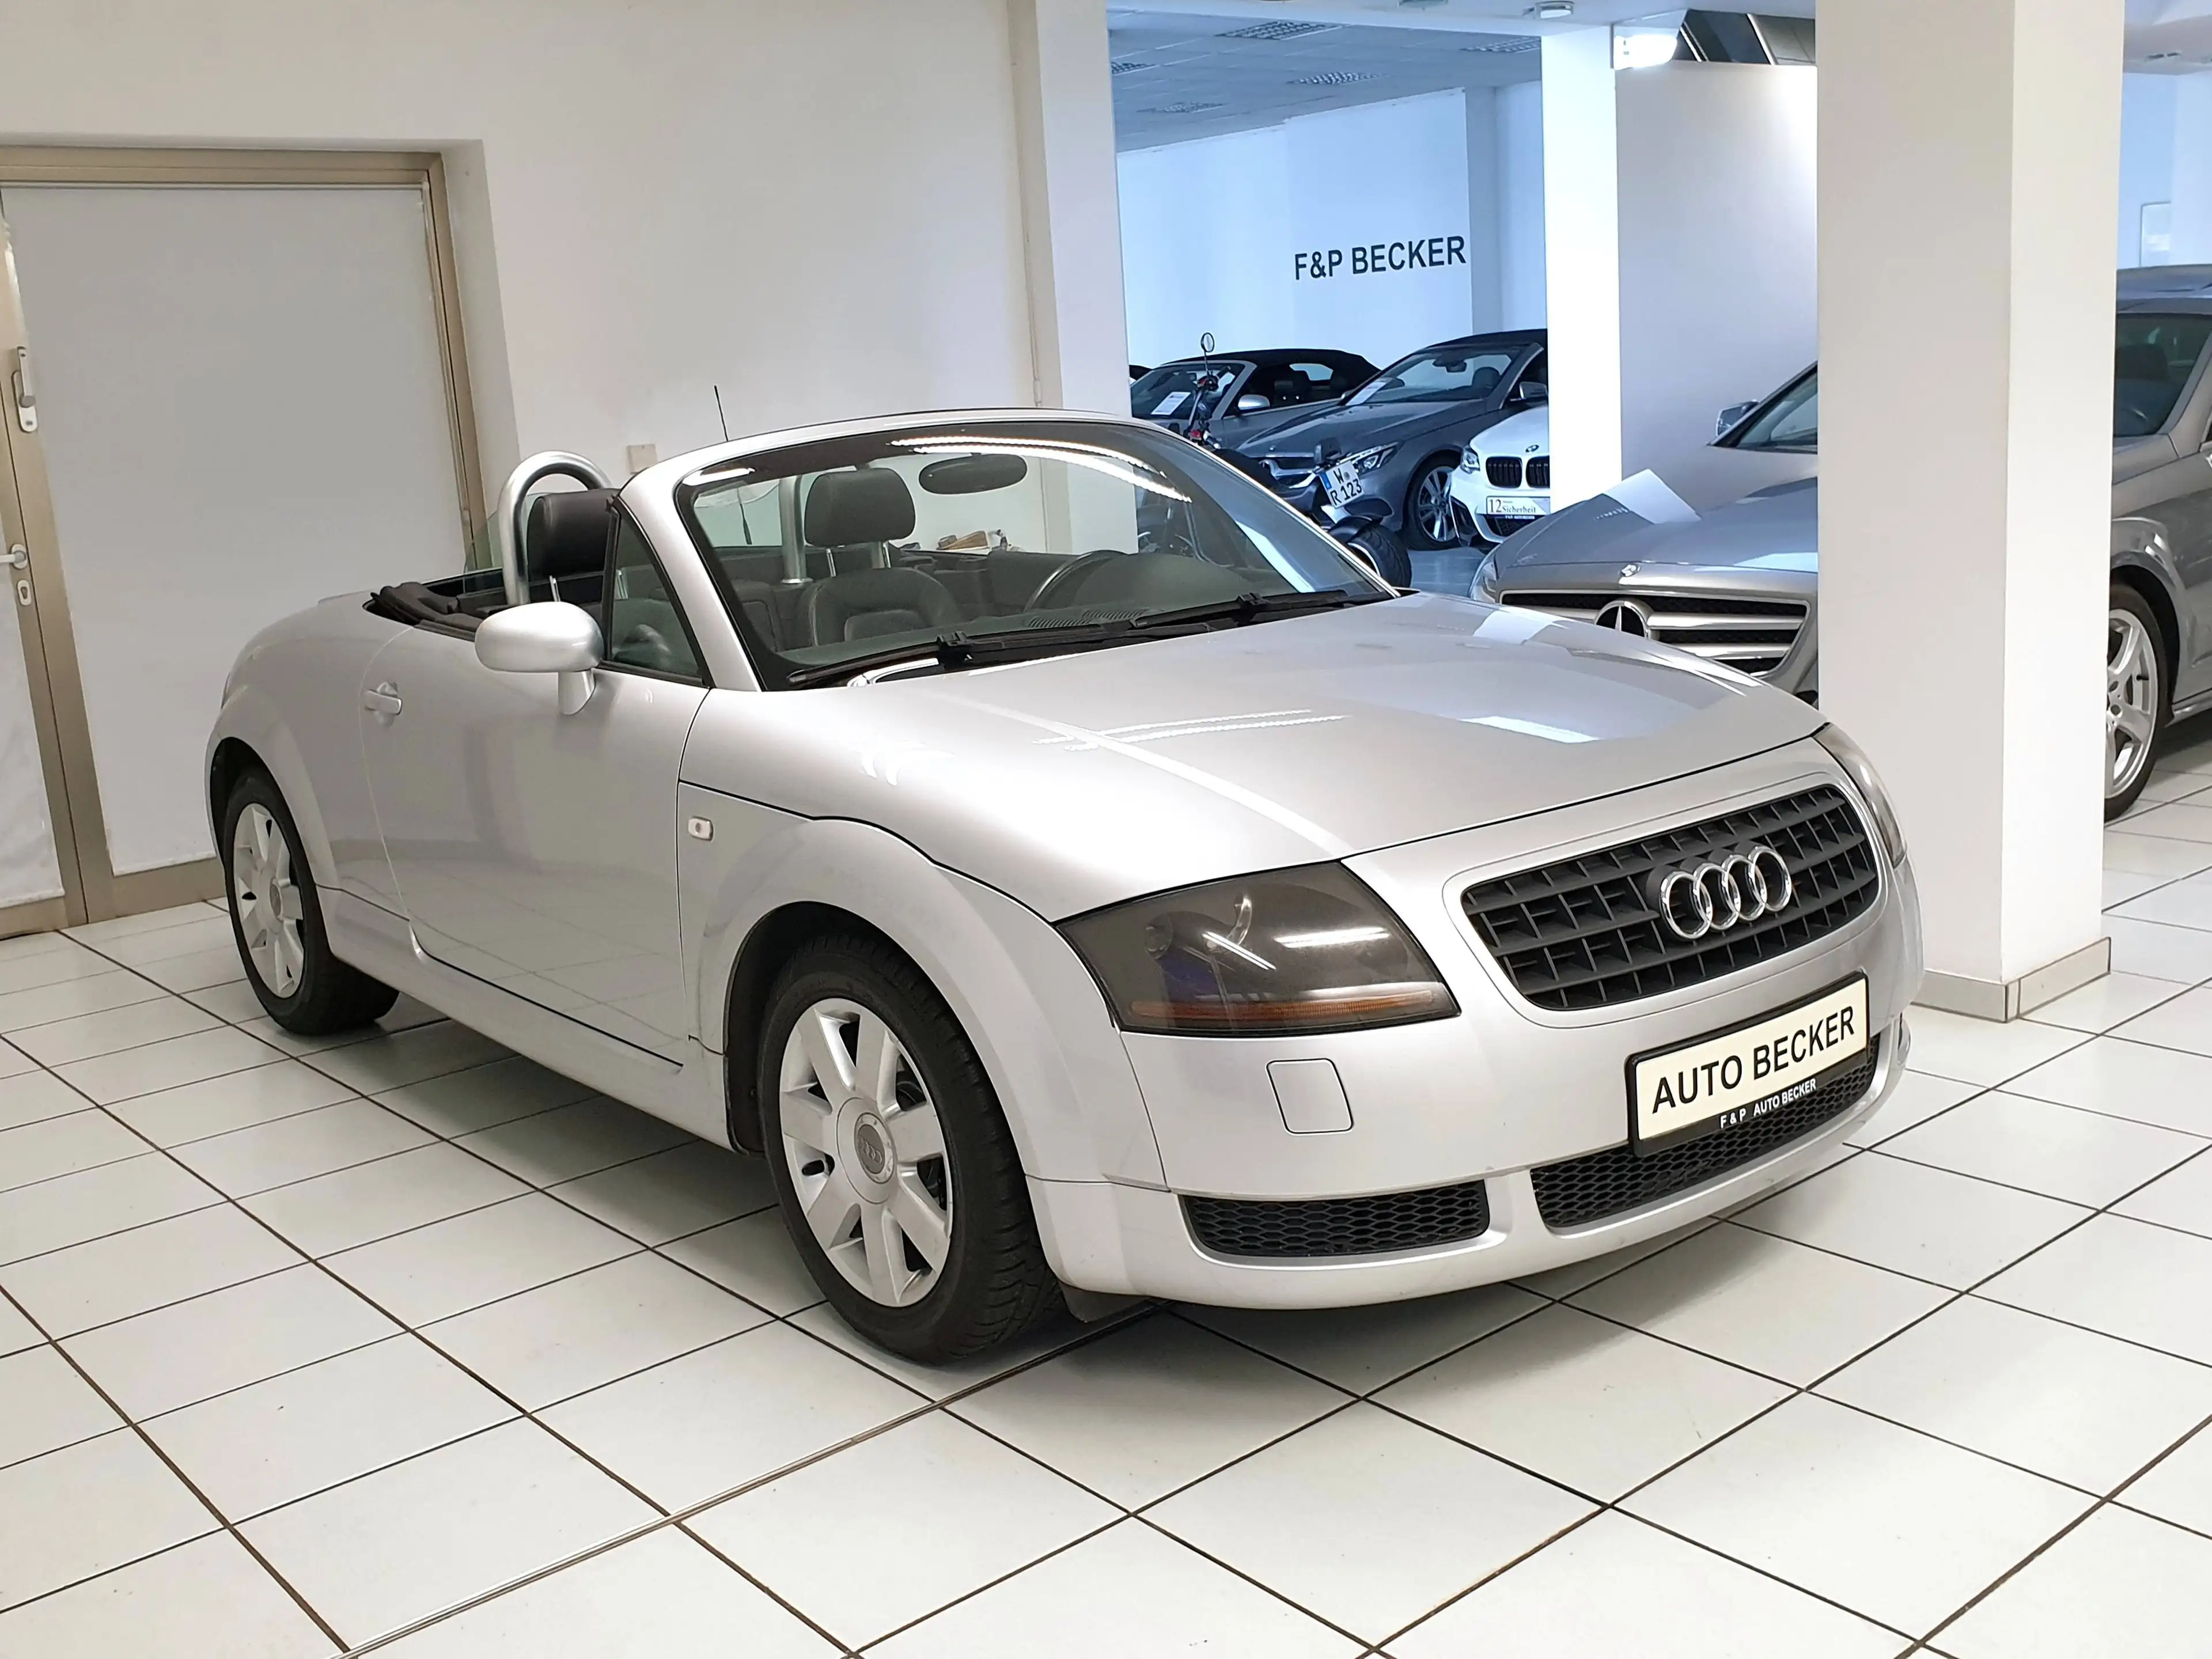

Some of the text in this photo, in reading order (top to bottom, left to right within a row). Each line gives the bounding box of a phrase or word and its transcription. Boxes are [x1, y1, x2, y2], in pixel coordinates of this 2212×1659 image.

[1294, 235, 1467, 281] F&P BECKER
[1330, 478, 1362, 506] R 123
[1333, 467, 1344, 484] W
[1488, 498, 1536, 513] 12 Sicherheit
[1652, 1005, 1855, 1115] AUTO BECKER
[1753, 1094, 1780, 1117] AUTO
[1781, 1077, 1817, 1106] BECKER
